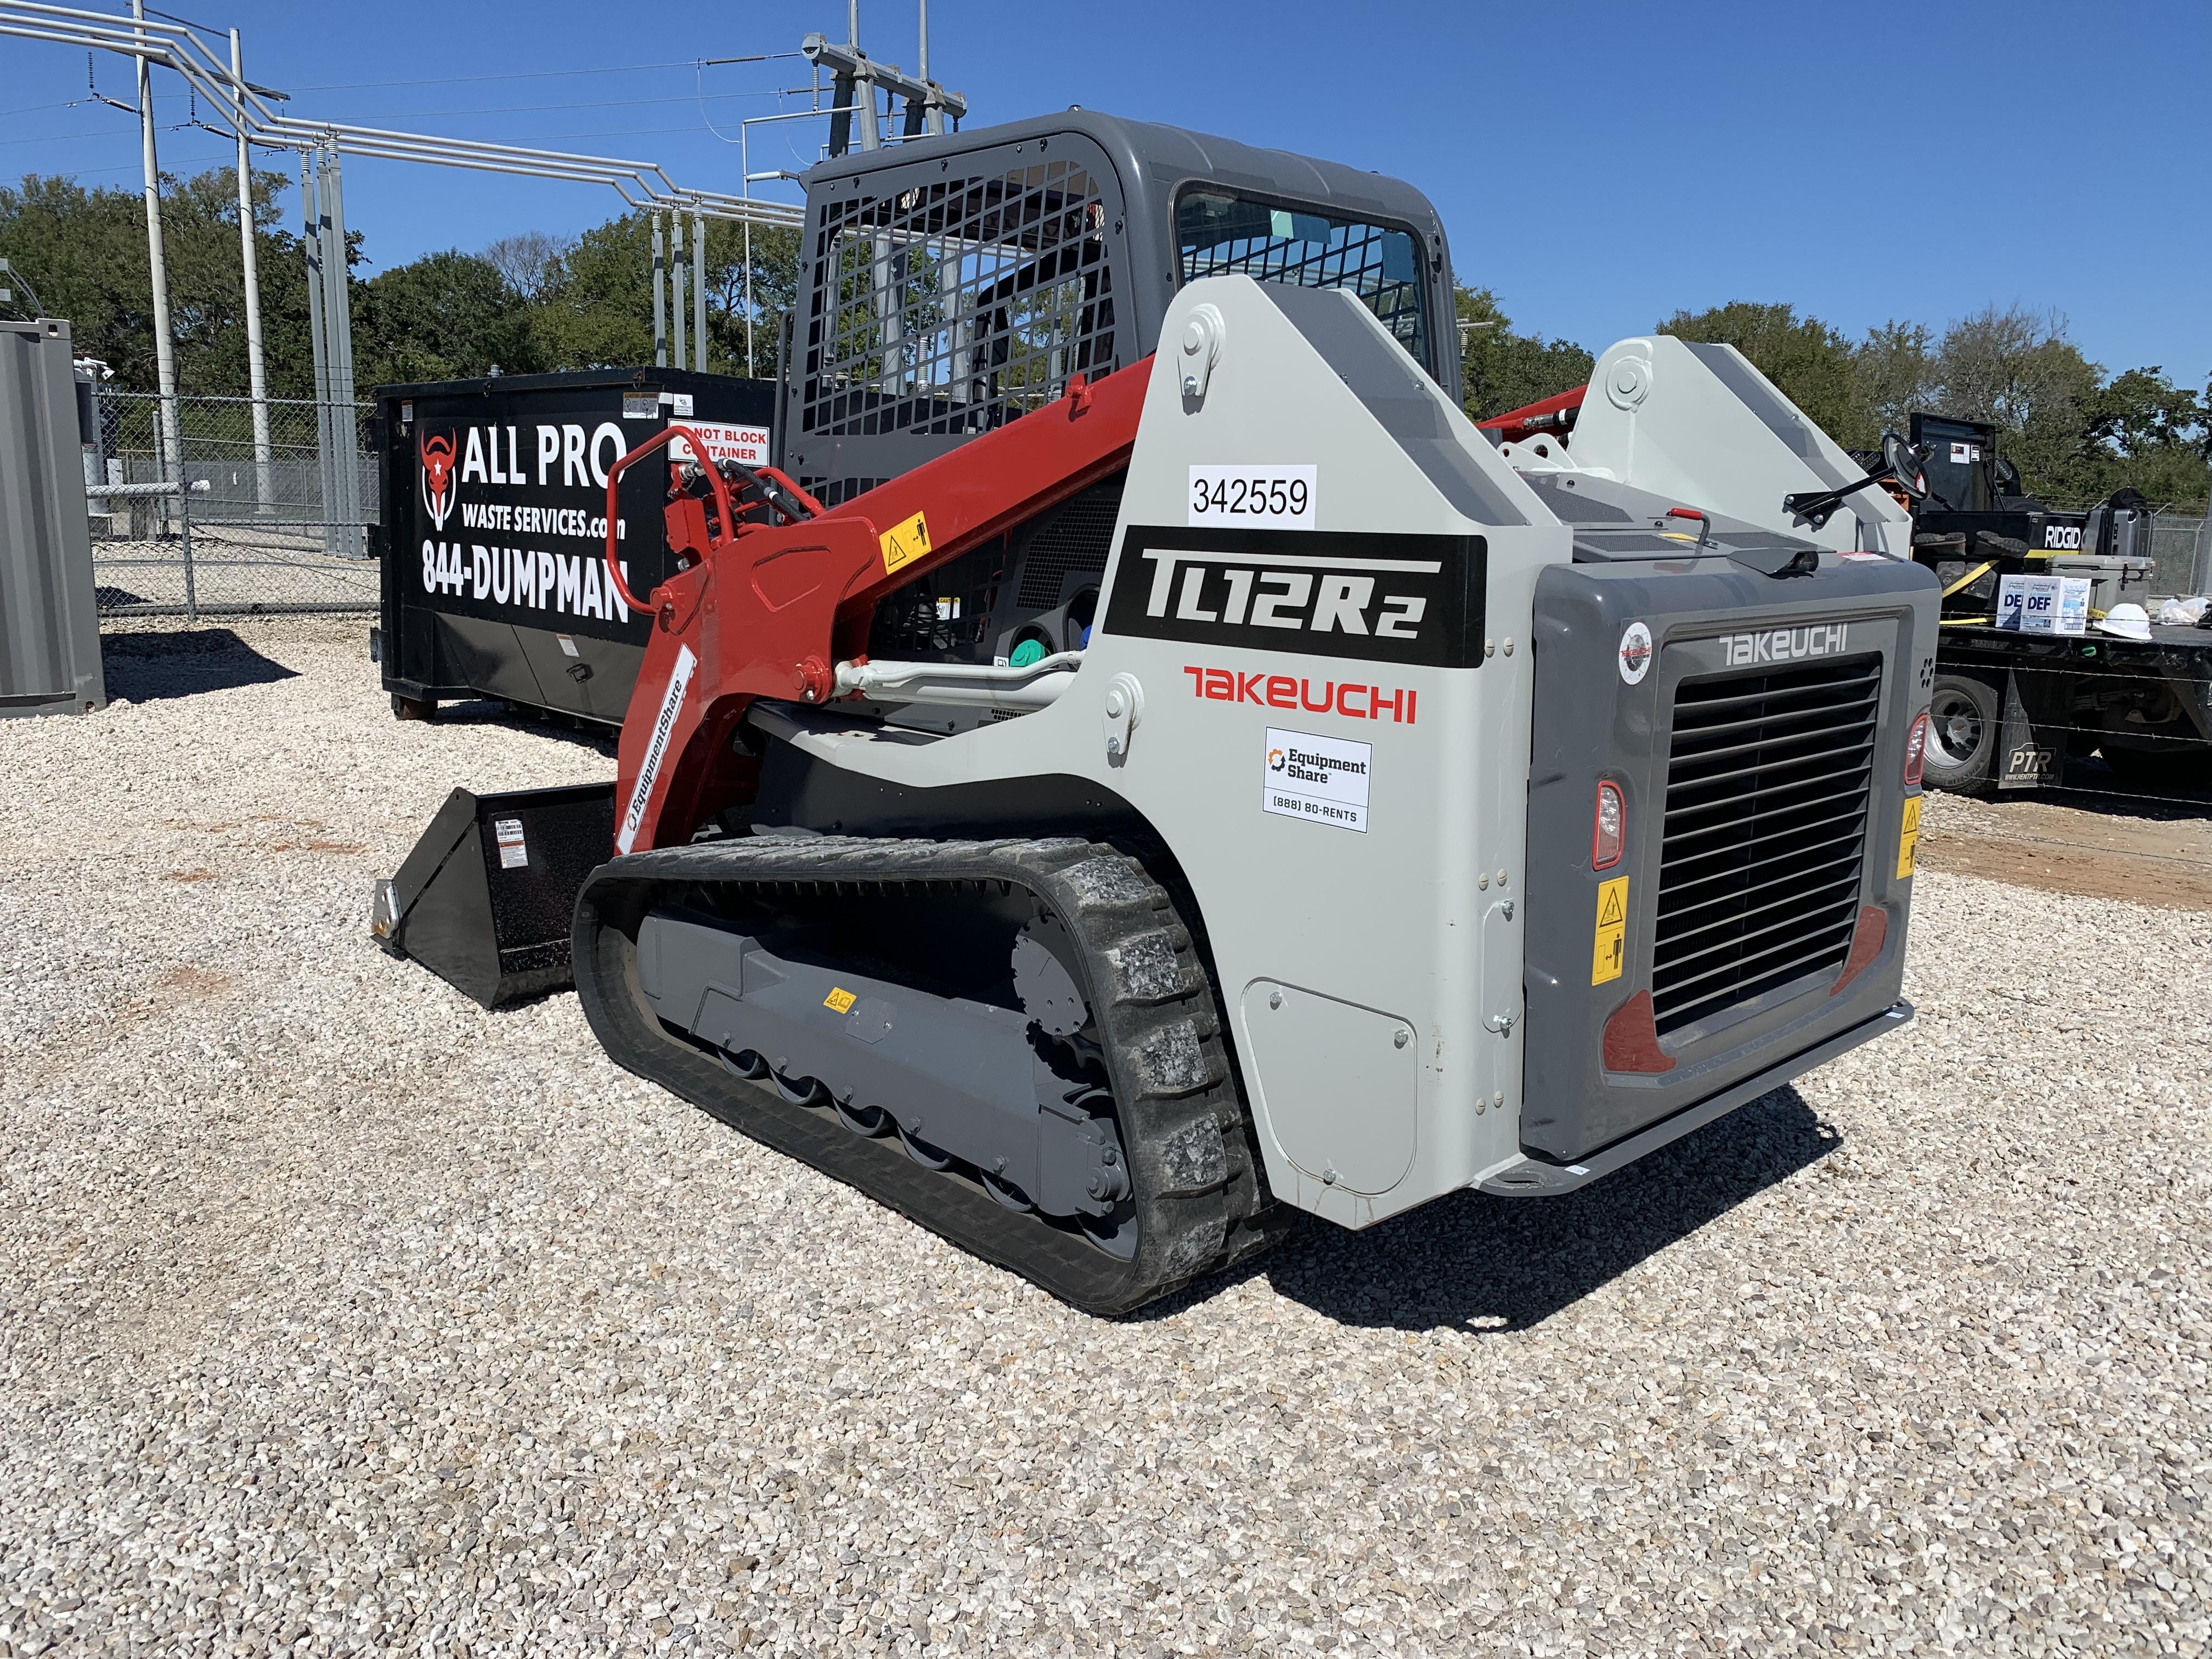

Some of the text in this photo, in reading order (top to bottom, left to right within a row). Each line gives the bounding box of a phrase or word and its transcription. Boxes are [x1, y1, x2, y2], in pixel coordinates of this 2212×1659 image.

[694, 427, 766, 444] NOT BLOCK
[461, 422, 627, 489] ALL PRO
[682, 443, 756, 460] CTAINER
[1193, 478, 1308, 515] 342559
[462, 503, 511, 531] WASTE
[2045, 526, 2081, 549] RIDGID
[422, 539, 628, 623] 844-DUMPMAN
[1142, 549, 1442, 639] TL12R2
[2004, 594, 2024, 608] DE
[2028, 596, 2051, 611] DEF
[631, 679, 682, 816] EquipmentShare
[1288, 764, 1328, 784] Share
[1289, 748, 1366, 775] Equipment
[2009, 751, 2052, 772] PTR
[1273, 795, 1357, 822] (888) 80-RENTS
